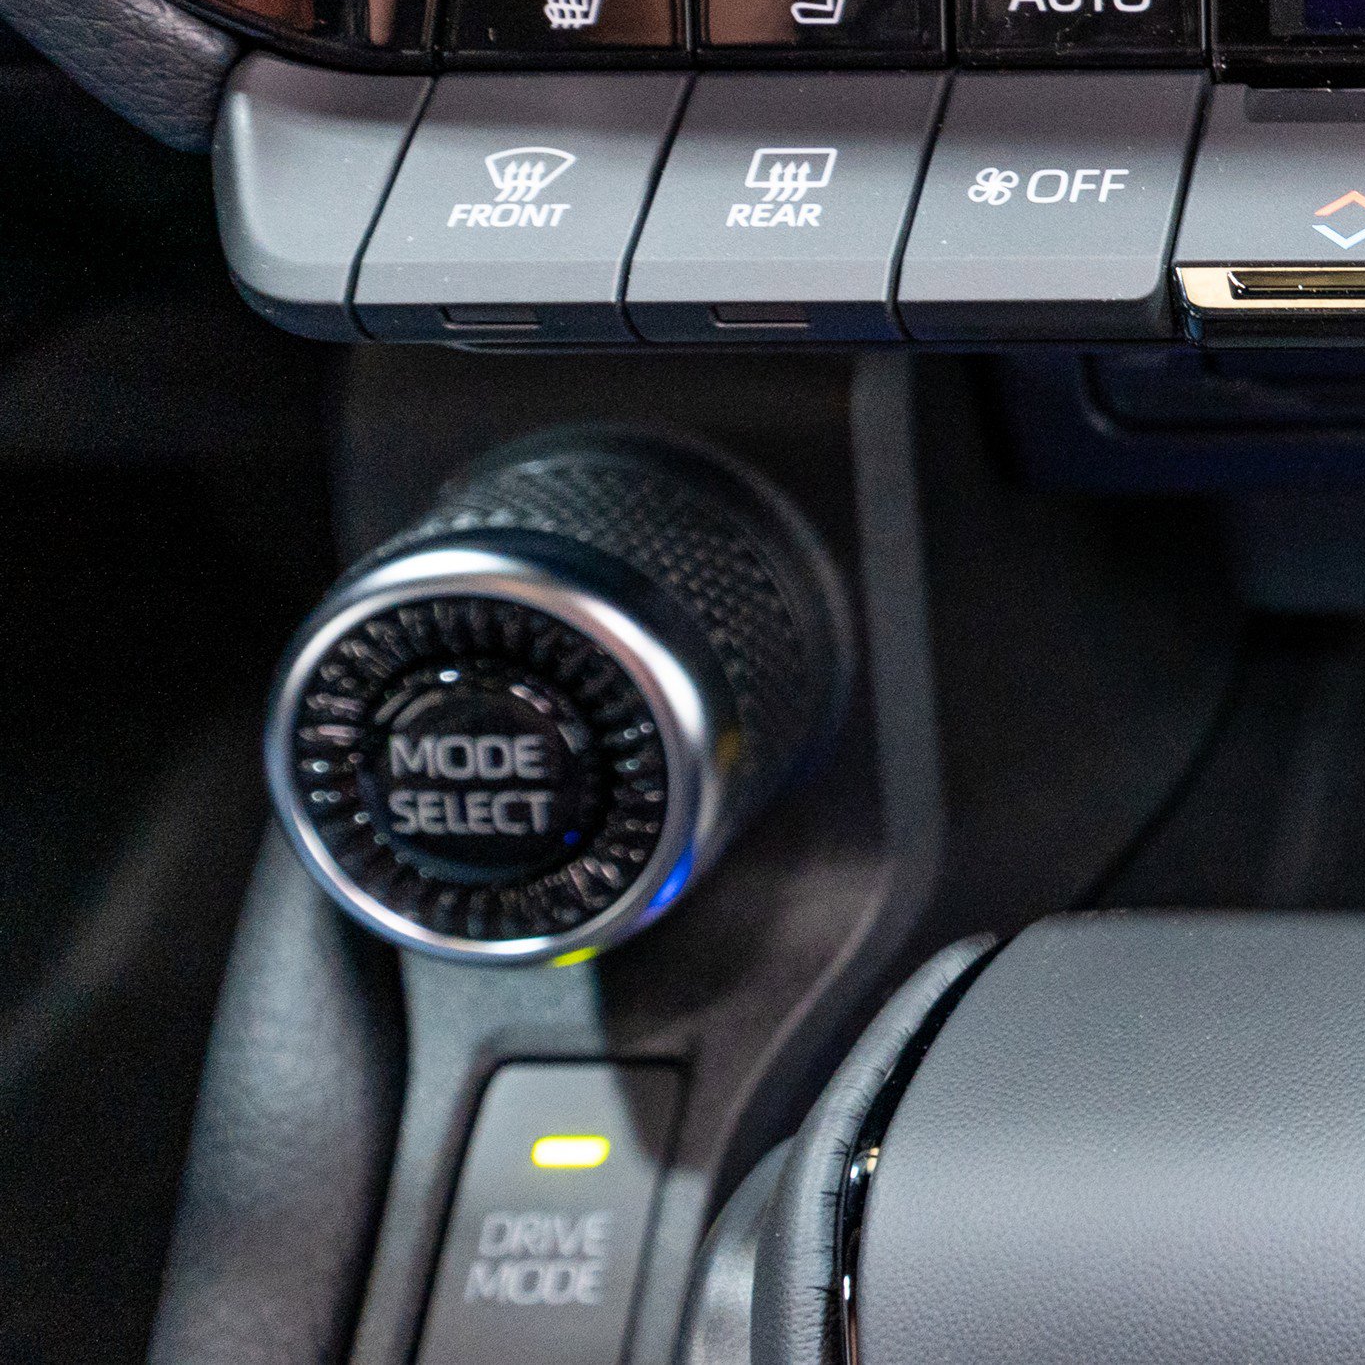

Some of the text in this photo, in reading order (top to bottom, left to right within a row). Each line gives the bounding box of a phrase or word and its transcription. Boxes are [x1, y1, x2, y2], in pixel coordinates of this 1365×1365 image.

[1026, 168, 1130, 204] OFF
[447, 203, 572, 228] FRONT
[726, 203, 823, 228] REAR
[387, 733, 548, 781] MODE
[388, 788, 555, 836] SELECT
[477, 1209, 615, 1260] DRIVE
[463, 1259, 604, 1306] MODE
